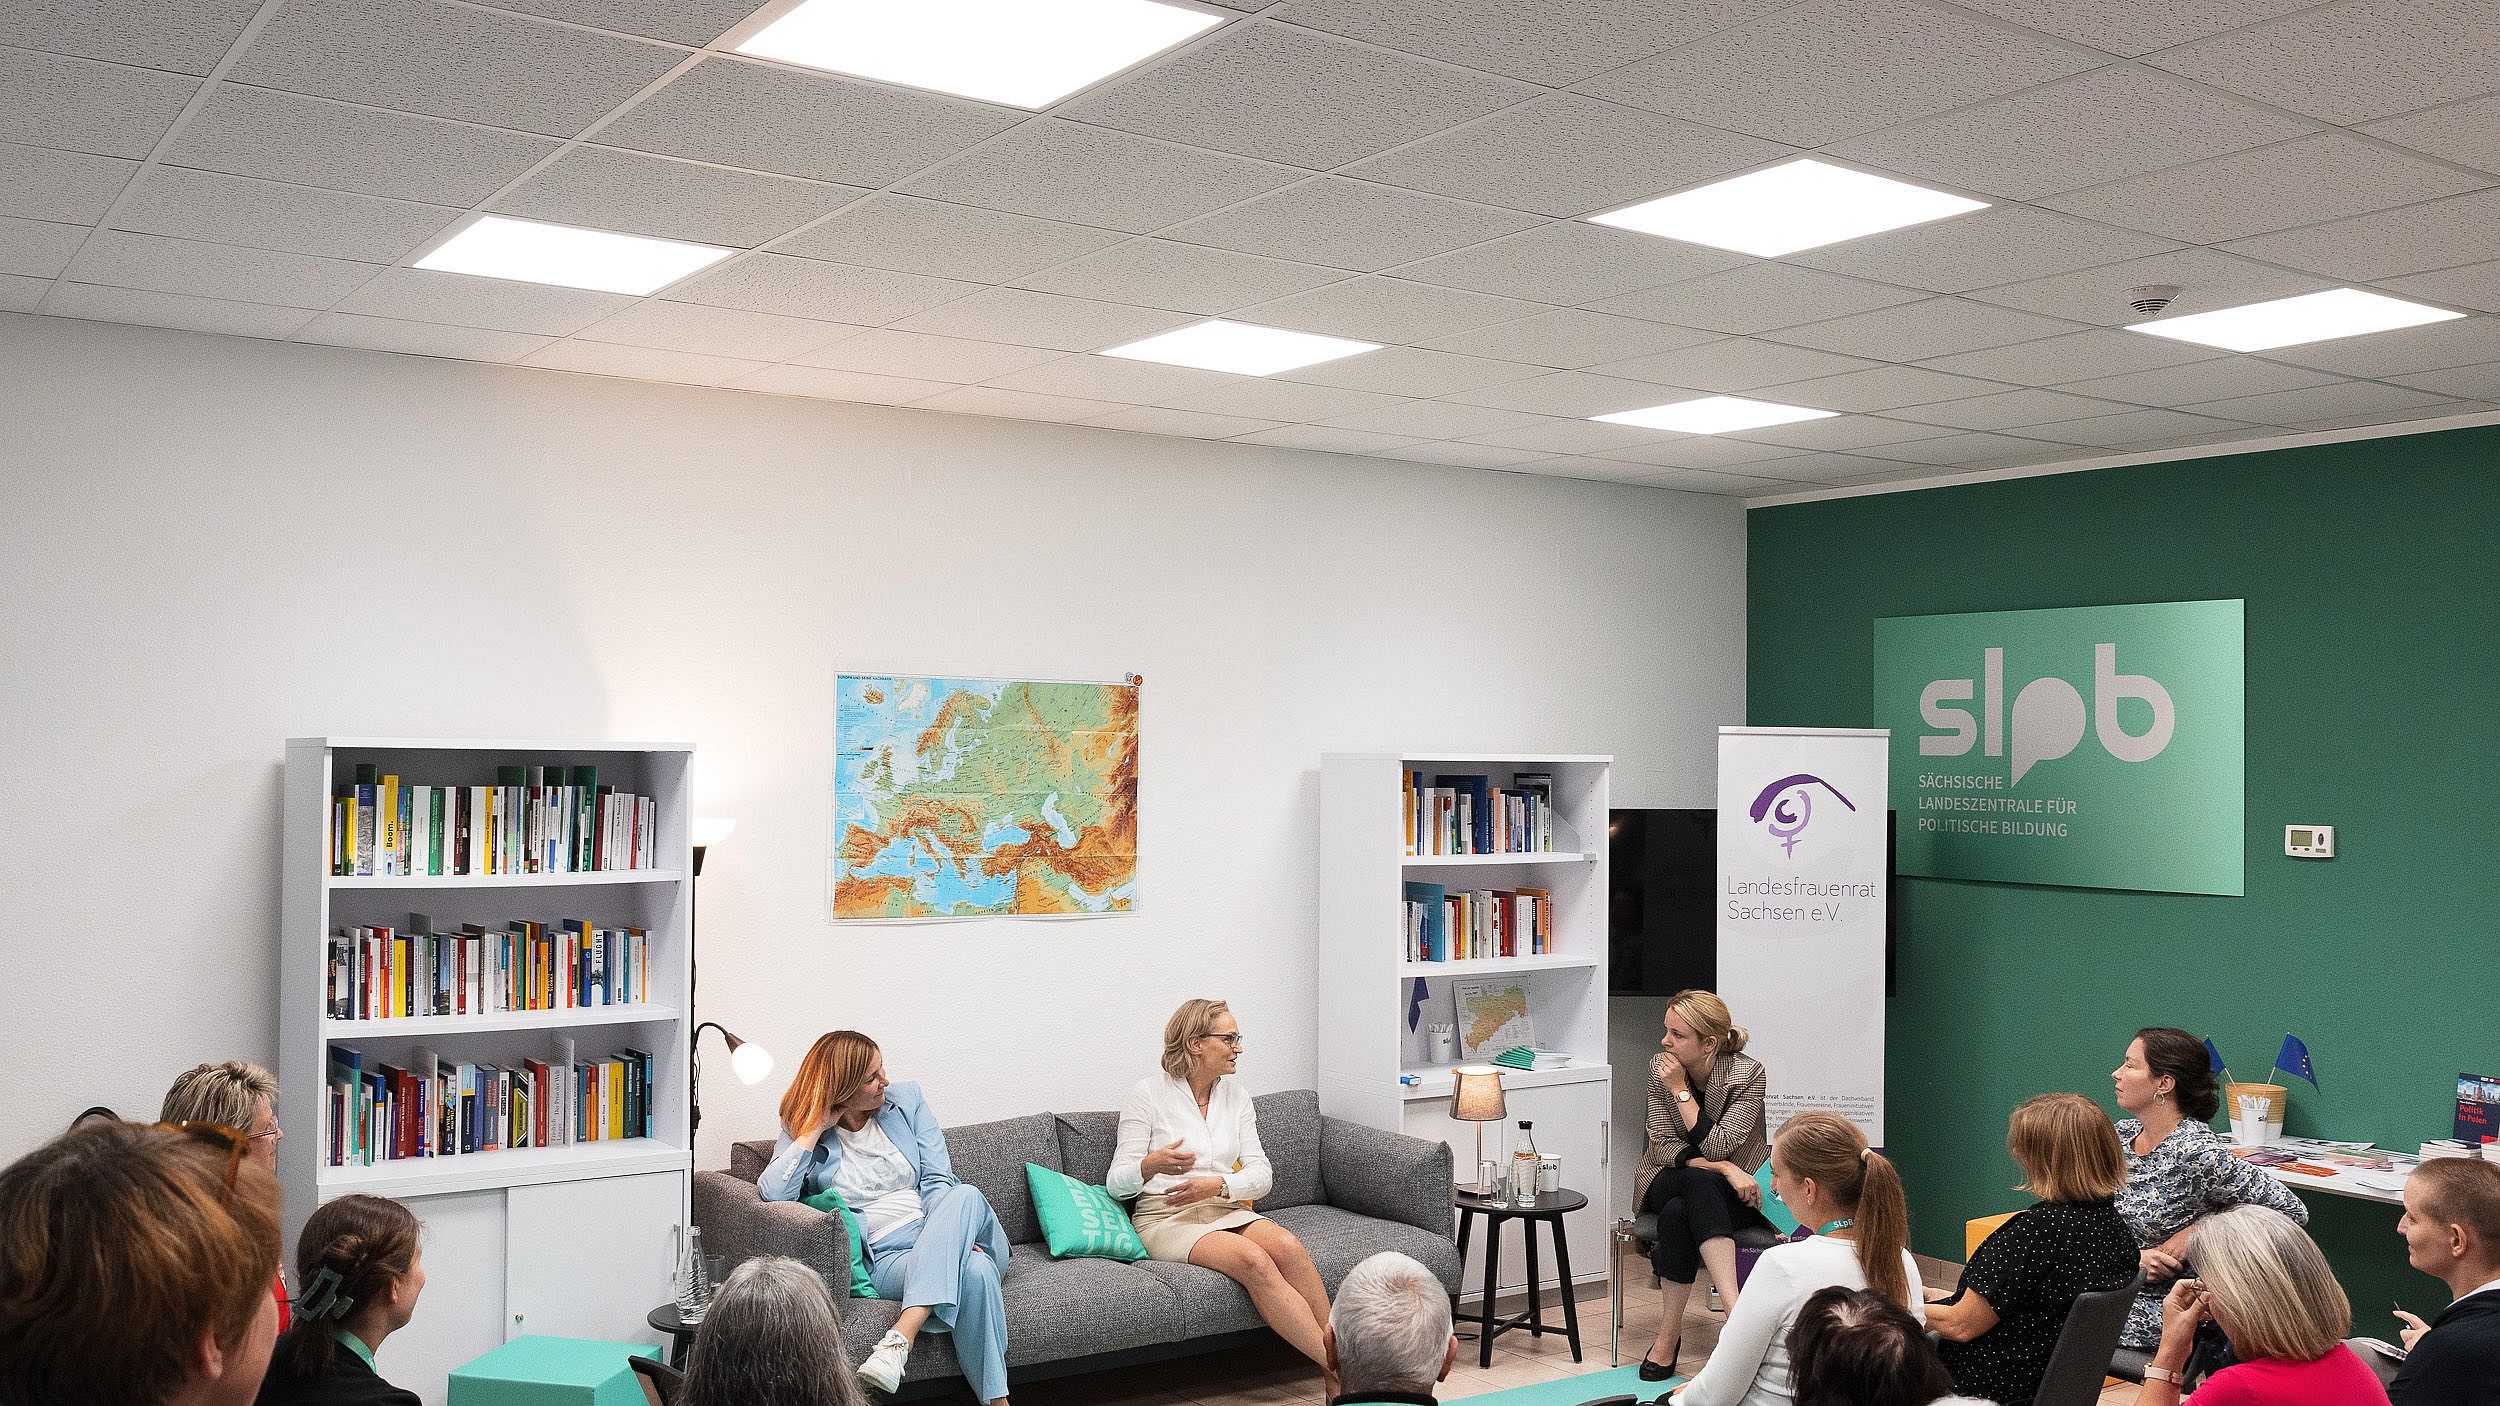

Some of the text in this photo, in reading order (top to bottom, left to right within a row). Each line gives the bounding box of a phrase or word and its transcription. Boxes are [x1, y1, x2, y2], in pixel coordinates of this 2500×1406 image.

[1919, 643, 2176, 789] slpb
[1918, 772, 2003, 790] SÄCHSISCHE
[1918, 796, 2077, 815] LANDESZENTRALE FÜR
[386, 820, 394, 848] Boom.
[1918, 818, 2068, 838] POLITISCHE BILDUNG
[1727, 875, 1877, 898] Landesfrauenrat
[1727, 900, 1844, 922] Sachsen e.V.
[2460, 1104, 2484, 1116] Politik
[2468, 1114, 2489, 1125] Polen
